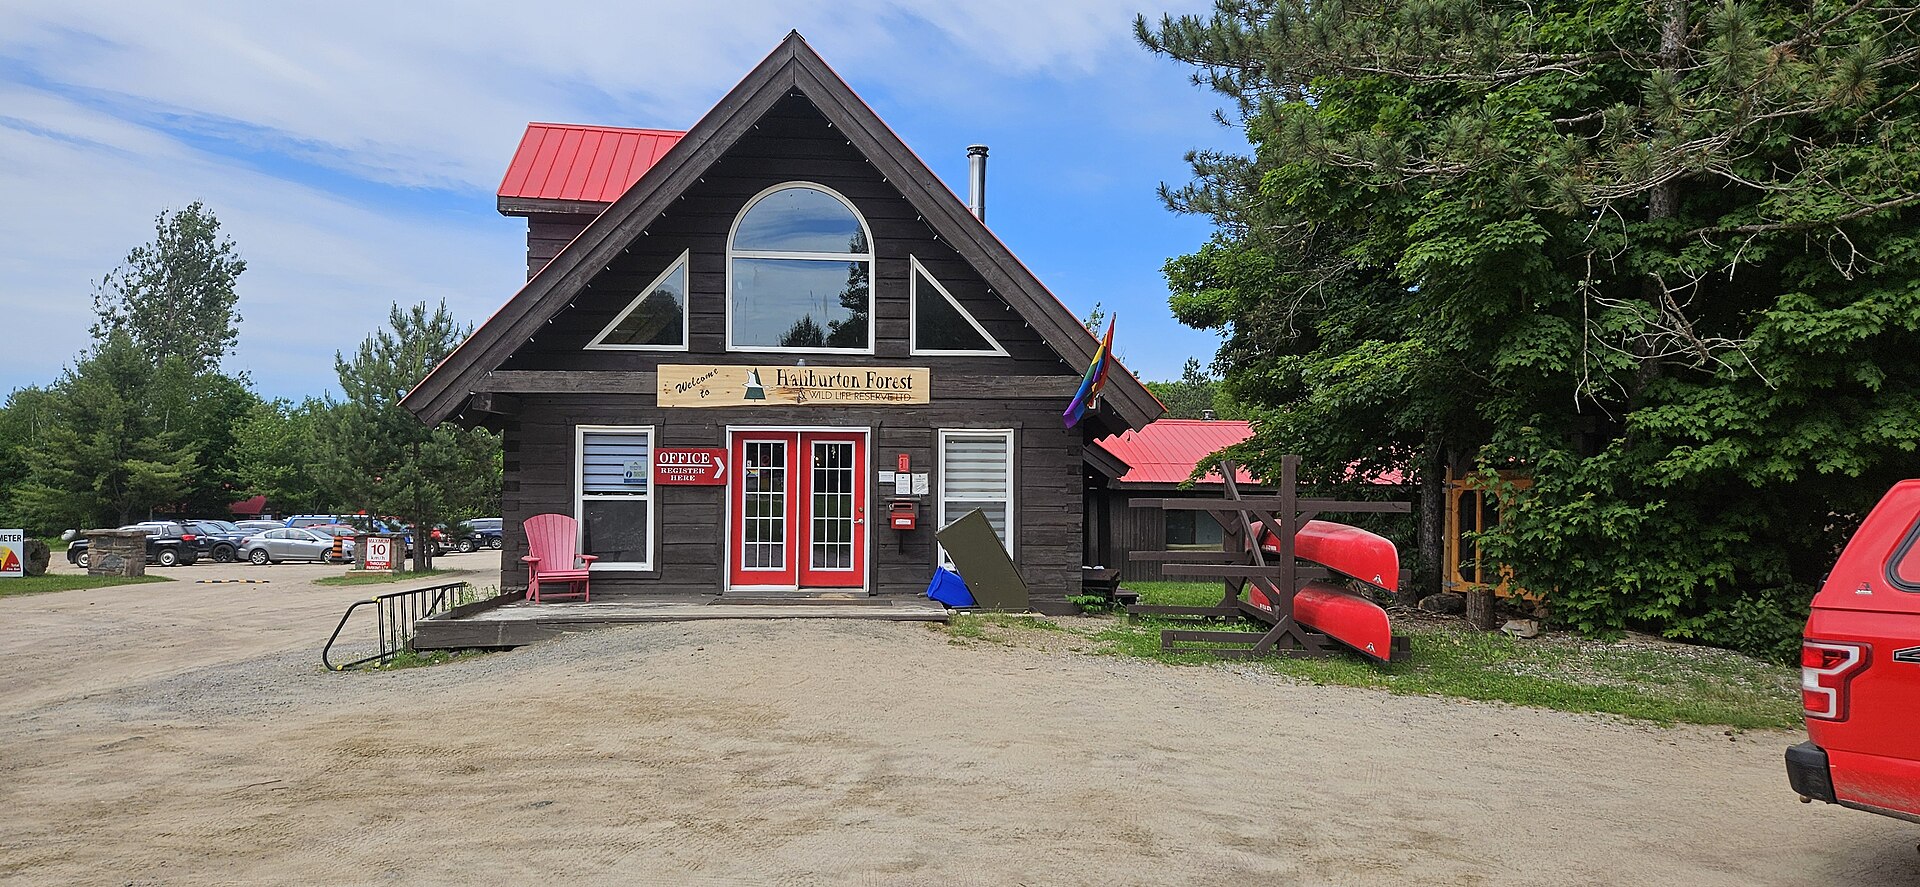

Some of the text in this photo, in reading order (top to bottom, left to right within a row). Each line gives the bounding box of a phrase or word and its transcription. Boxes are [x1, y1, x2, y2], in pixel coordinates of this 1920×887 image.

[675, 368, 719, 393] Welcome
[776, 368, 913, 389] Haliburton Forest
[699, 388, 710, 399] to
[809, 391, 833, 400] WILD
[835, 391, 851, 400] LIFE
[854, 392, 893, 401] RESERVE
[895, 393, 912, 402] LTD
[659, 452, 710, 464] OFFICE
[371, 544, 386, 555] 10
